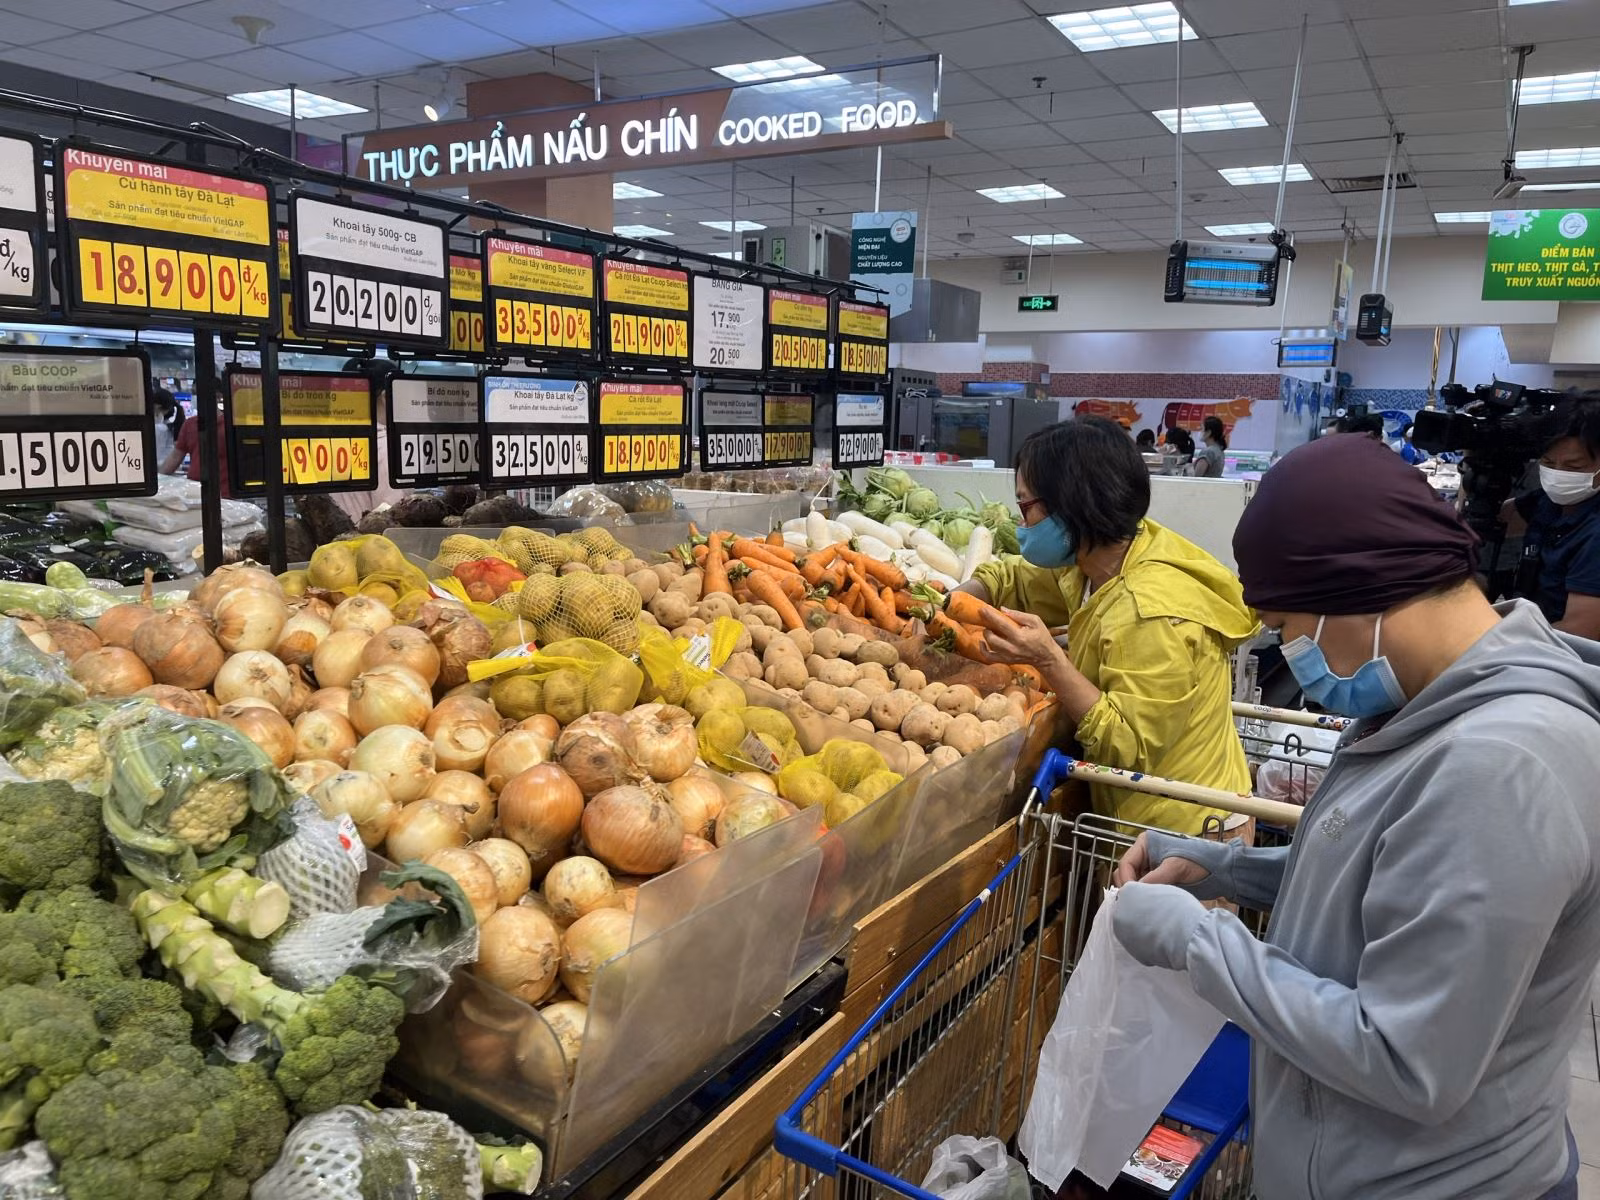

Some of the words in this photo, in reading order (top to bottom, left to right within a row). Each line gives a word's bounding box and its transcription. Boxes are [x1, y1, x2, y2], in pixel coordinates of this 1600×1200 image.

[719, 111, 822, 146] COOKED
[841, 100, 918, 133] FOOD
[363, 144, 439, 187] THỰC
[450, 121, 534, 174] PHẨM
[544, 112, 607, 165] NẤU
[620, 108, 698, 157] CHÍN
[141, 180, 173, 197] hành
[175, 185, 195, 202] tây
[197, 189, 214, 203] Đà
[216, 194, 235, 208] Lạt
[213, 215, 245, 228] VietGAP
[333, 217, 360, 232] Khoai
[362, 223, 376, 236] tây
[404, 232, 417, 243] CB
[400, 246, 423, 257] VietGAP
[1541, 243, 1570, 258] ĐIỂM
[1572, 245, 1595, 258] BÁN
[90, 250, 236, 302] 18.900
[508, 255, 528, 266] Khoai
[529, 260, 540, 270] tây
[541, 262, 557, 273] vàng
[558, 264, 577, 276] Select
[1491, 262, 1515, 274] THỊT
[1517, 263, 1542, 273] HEO,
[1545, 262, 1569, 274] THỊT
[1571, 260, 1590, 273] GÀ,
[1505, 277, 1534, 287] TRUY
[1536, 273, 1564, 287] XUẤT
[312, 280, 417, 325] 20.200
[498, 306, 577, 340] 33.500
[613, 319, 674, 347] 21.900
[775, 339, 816, 363] 20.500
[12, 364, 37, 376] Bầu
[40, 365, 78, 377] COOP
[81, 384, 114, 392] VietGAP
[325, 391, 337, 401] Kg
[462, 388, 470, 398] kg
[514, 390, 534, 399] Khoai
[534, 391, 545, 401] tây
[546, 391, 555, 400] Đà
[555, 392, 566, 402] Lạt
[495, 440, 570, 468] 32.500
[608, 440, 667, 466] 18.900
[709, 438, 752, 458] 35.000
[765, 436, 802, 455] 17.900
[840, 436, 874, 457] 22.900
